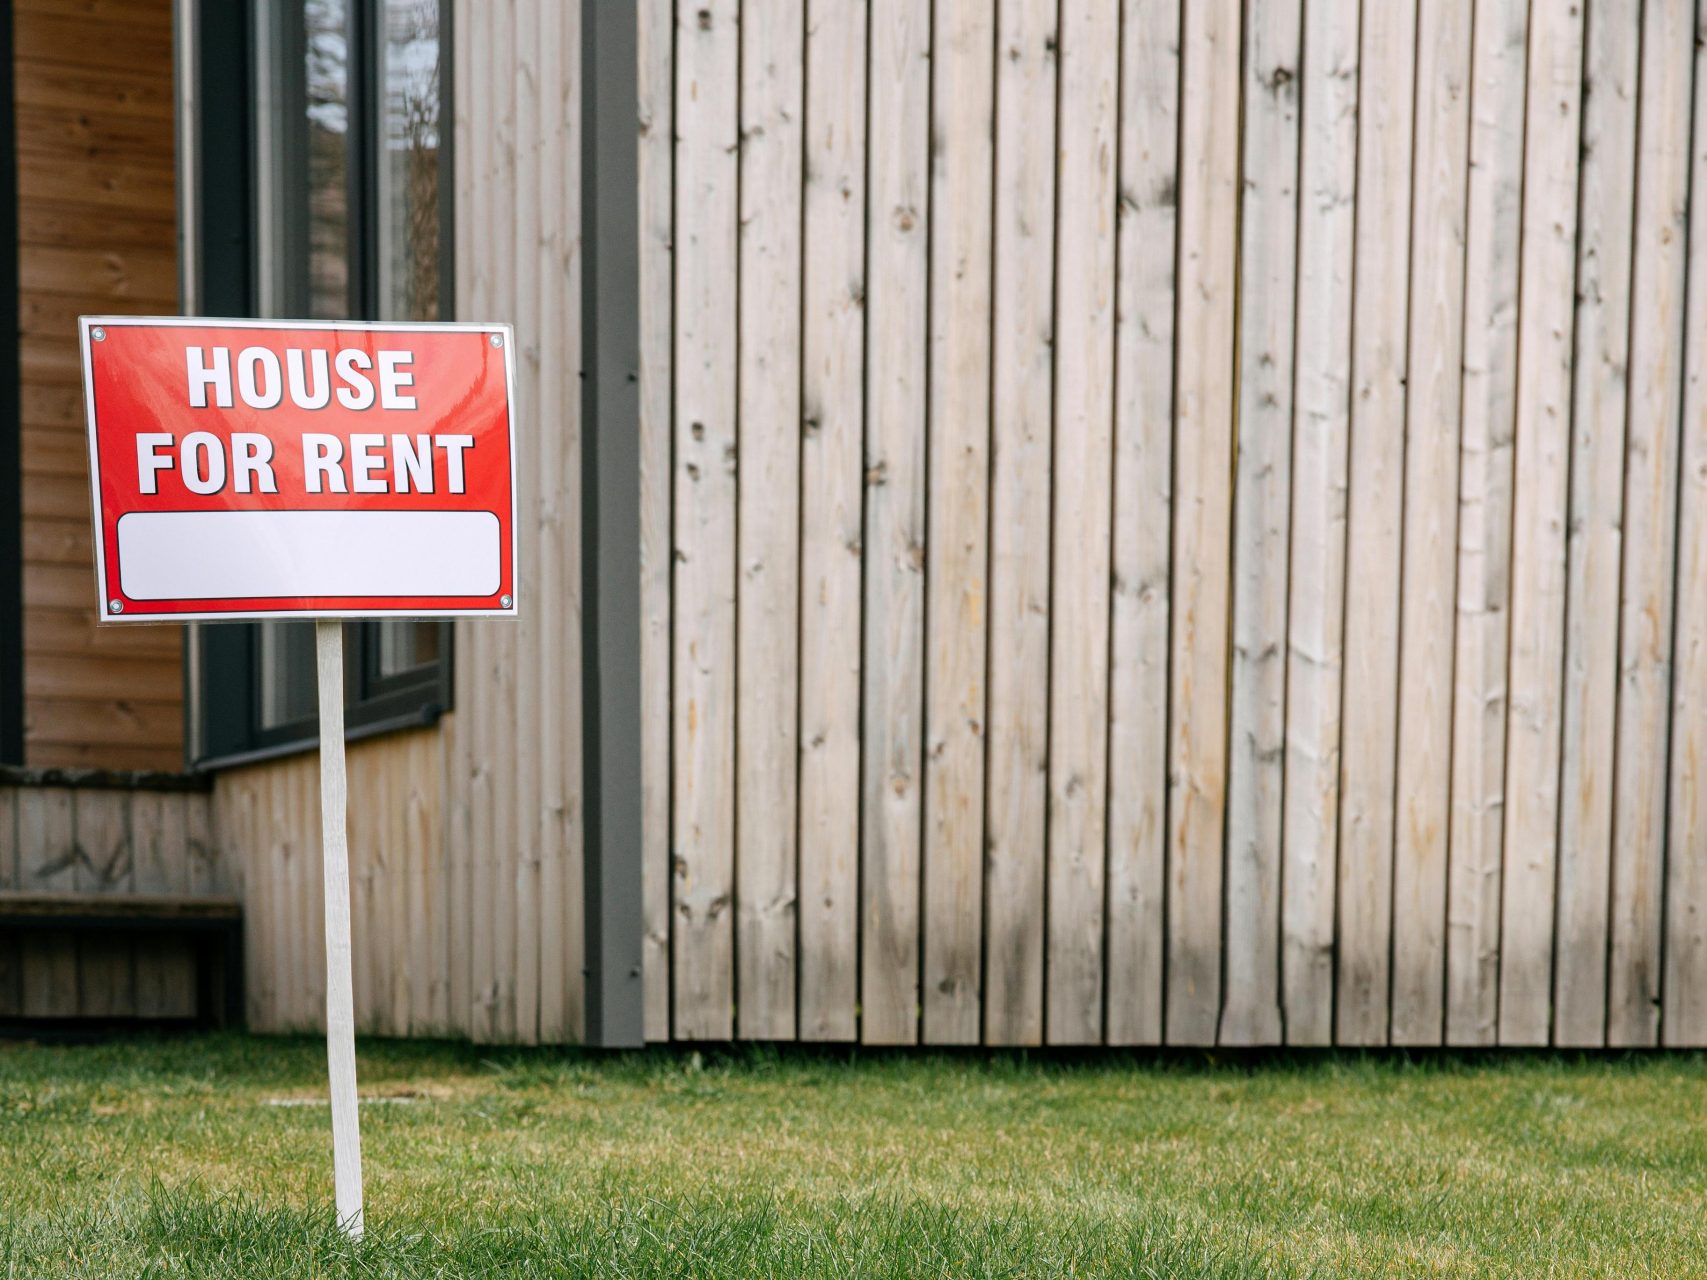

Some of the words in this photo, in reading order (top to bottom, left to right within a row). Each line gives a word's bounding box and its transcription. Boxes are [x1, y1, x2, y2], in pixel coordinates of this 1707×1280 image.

[185, 346, 417, 411] HOUSE
[136, 431, 278, 495] FOR
[301, 433, 474, 495] RENT
